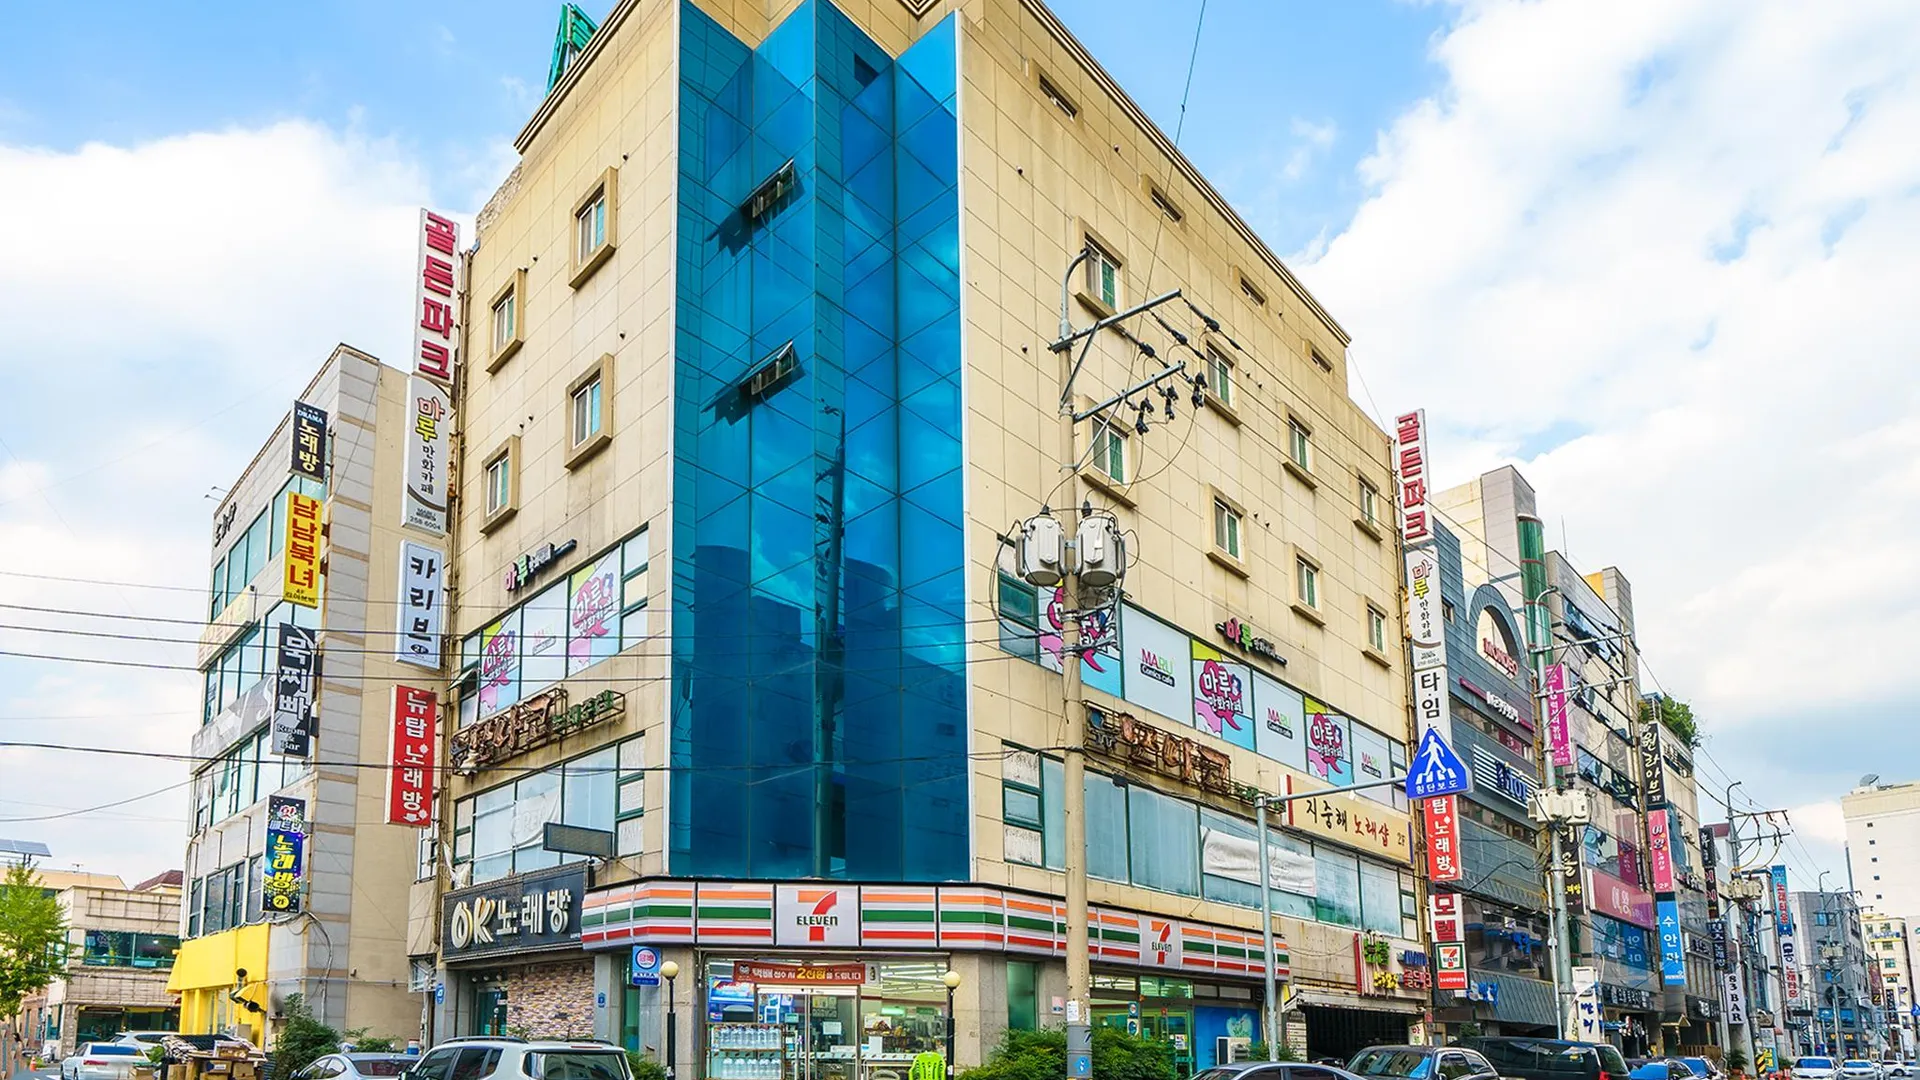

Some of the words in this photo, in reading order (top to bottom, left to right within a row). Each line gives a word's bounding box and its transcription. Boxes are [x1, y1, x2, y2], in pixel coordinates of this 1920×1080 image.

[418, 212, 456, 381] 골든파크
[297, 409, 324, 425] DRAMA
[414, 396, 446, 443] 마루
[298, 418, 321, 472] 노래방
[420, 445, 436, 496] 만화카페
[1398, 412, 1428, 540] 골든파크
[289, 494, 319, 589] 남남북녀
[504, 553, 531, 591] 마루
[1411, 558, 1433, 600] 마루
[407, 556, 437, 642] 카리브
[574, 581, 603, 620] 마루
[1222, 617, 1253, 652] 마루
[1419, 600, 1432, 639] 만화카페
[483, 636, 508, 673] 마루
[1141, 647, 1175, 675] MARU
[1141, 664, 1163, 683] Comics
[280, 635, 312, 721] 묵찌빠
[1203, 666, 1231, 697] 마루
[405, 692, 428, 739] 뉴탑
[1207, 694, 1243, 713] 만화카페
[1267, 707, 1292, 729] MARU
[276, 723, 306, 737] Room
[280, 739, 301, 751] Bar
[1312, 722, 1335, 746] 마루
[403, 744, 426, 811] 노래방
[1416, 779, 1459, 795] 횡단보도
[1306, 797, 1348, 833] 지중해
[272, 834, 297, 889] 노래방
[1433, 819, 1451, 871] 노래방
[796, 915, 839, 927] ELEVEN
[797, 890, 838, 941] 7
[1434, 893, 1457, 941] 모텔
[1150, 919, 1172, 965] 7
[1151, 941, 1173, 954] ELEVEN
[1443, 948, 1458, 967] 7
[1661, 915, 1680, 964] 수안마
[1730, 994, 1743, 1022] BAR
